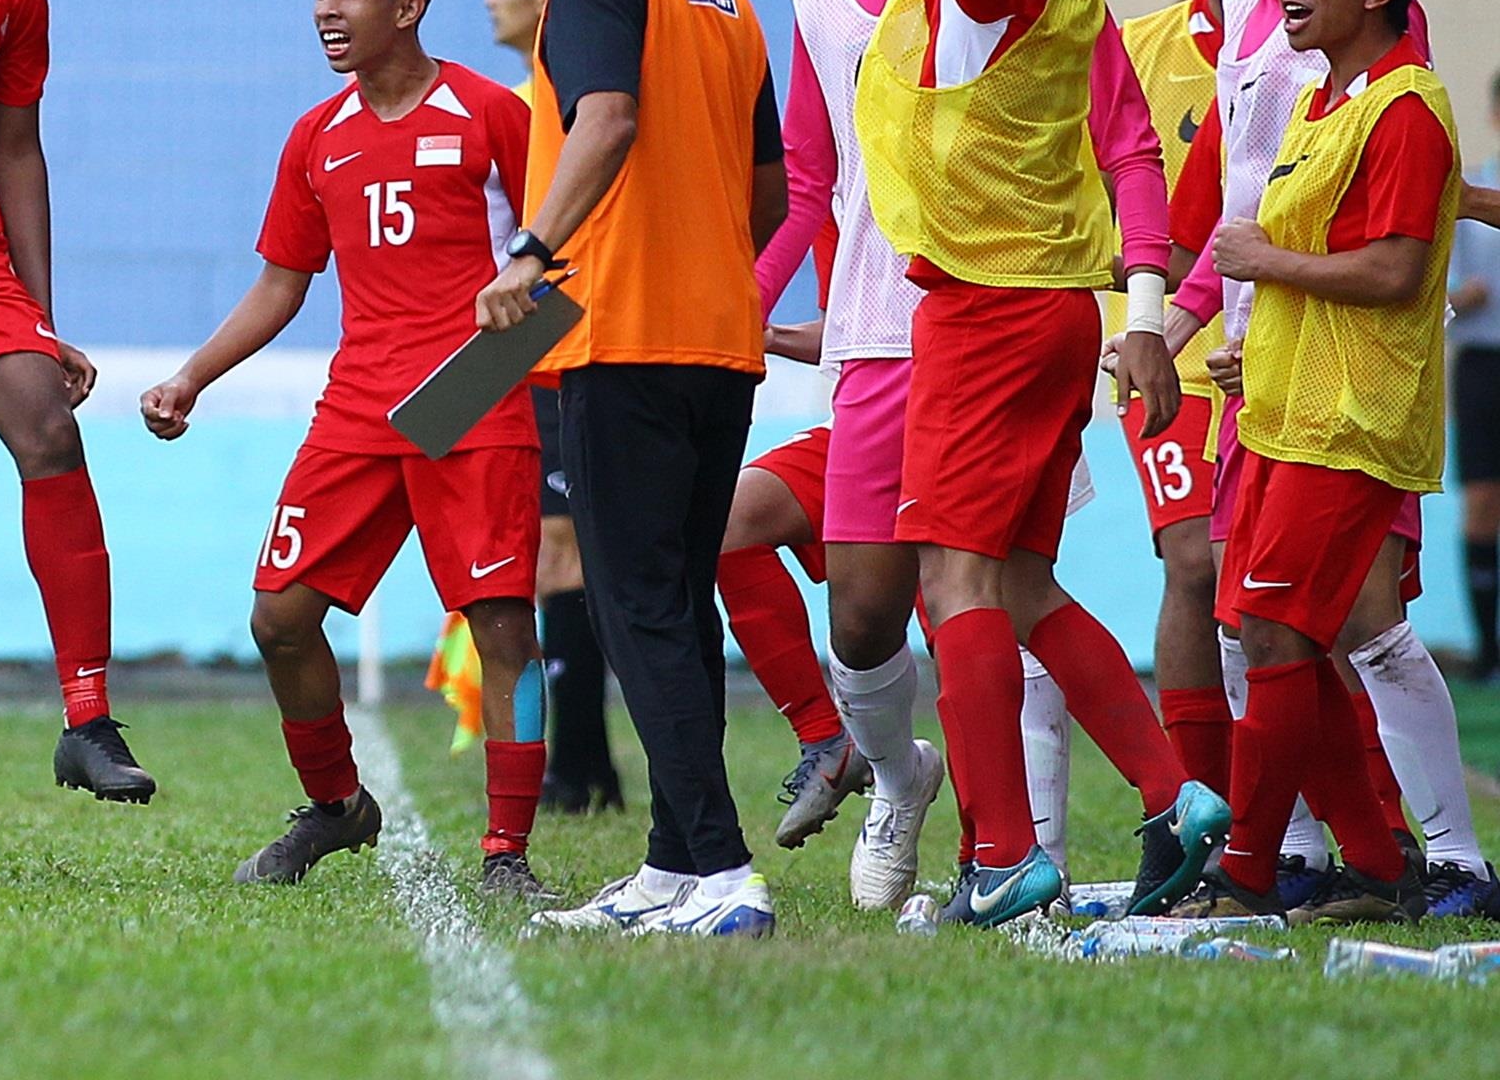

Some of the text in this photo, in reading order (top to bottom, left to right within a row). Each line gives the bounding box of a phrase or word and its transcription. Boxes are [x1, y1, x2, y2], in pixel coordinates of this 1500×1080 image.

[363, 180, 415, 248] 15
[1142, 441, 1193, 507] 13
[260, 504, 306, 569] 15
